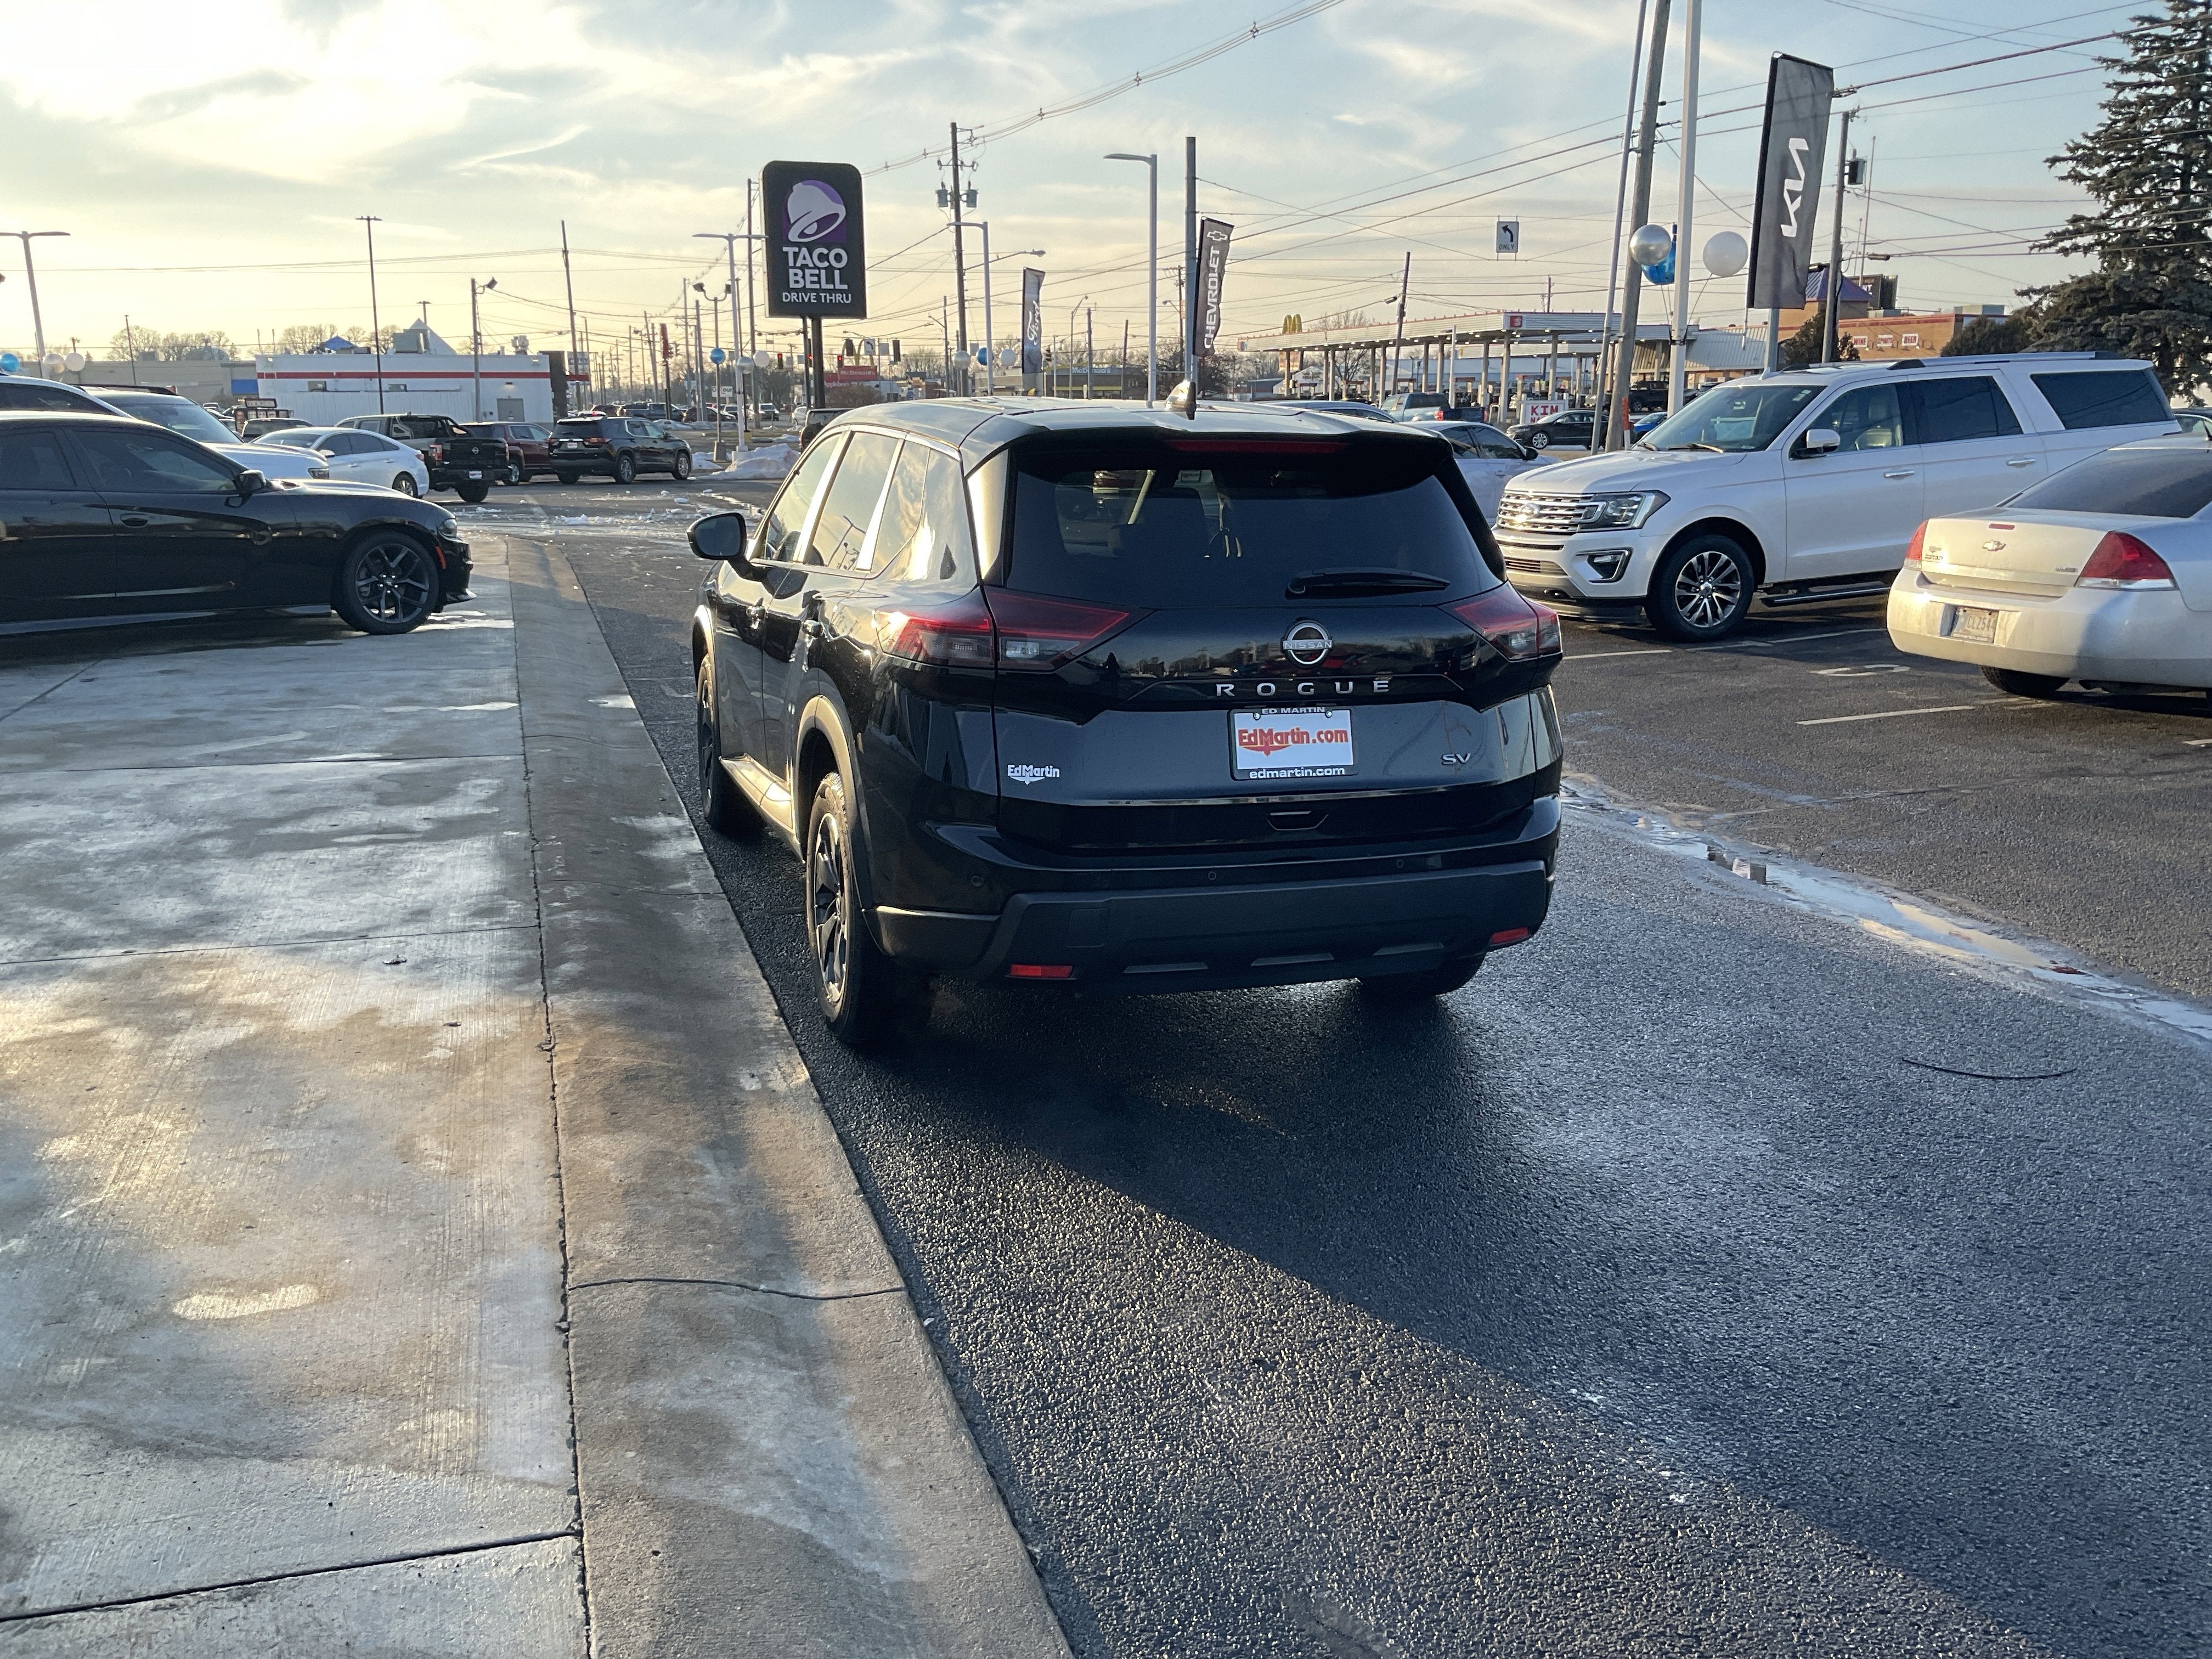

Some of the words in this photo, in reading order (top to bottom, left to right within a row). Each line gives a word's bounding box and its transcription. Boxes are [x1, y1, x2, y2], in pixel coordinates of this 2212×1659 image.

[1780, 137, 1809, 238] KIA
[782, 247, 848, 268] TACO
[788, 268, 848, 290] BELL
[782, 292, 817, 303] DRIVE
[819, 292, 852, 303] THRU
[1204, 245, 1220, 349] CHEVROLET
[1027, 300, 1040, 346] Ford
[1904, 336, 1917, 344] BEER
[1530, 405, 1559, 416] KIM
[1283, 640, 1332, 650] NISSAN
[1216, 680, 1390, 697] ROGUE
[1441, 753, 1471, 765] SV
[1007, 764, 1060, 778] EdMartin
[1249, 766, 1345, 779] edmartin.com
